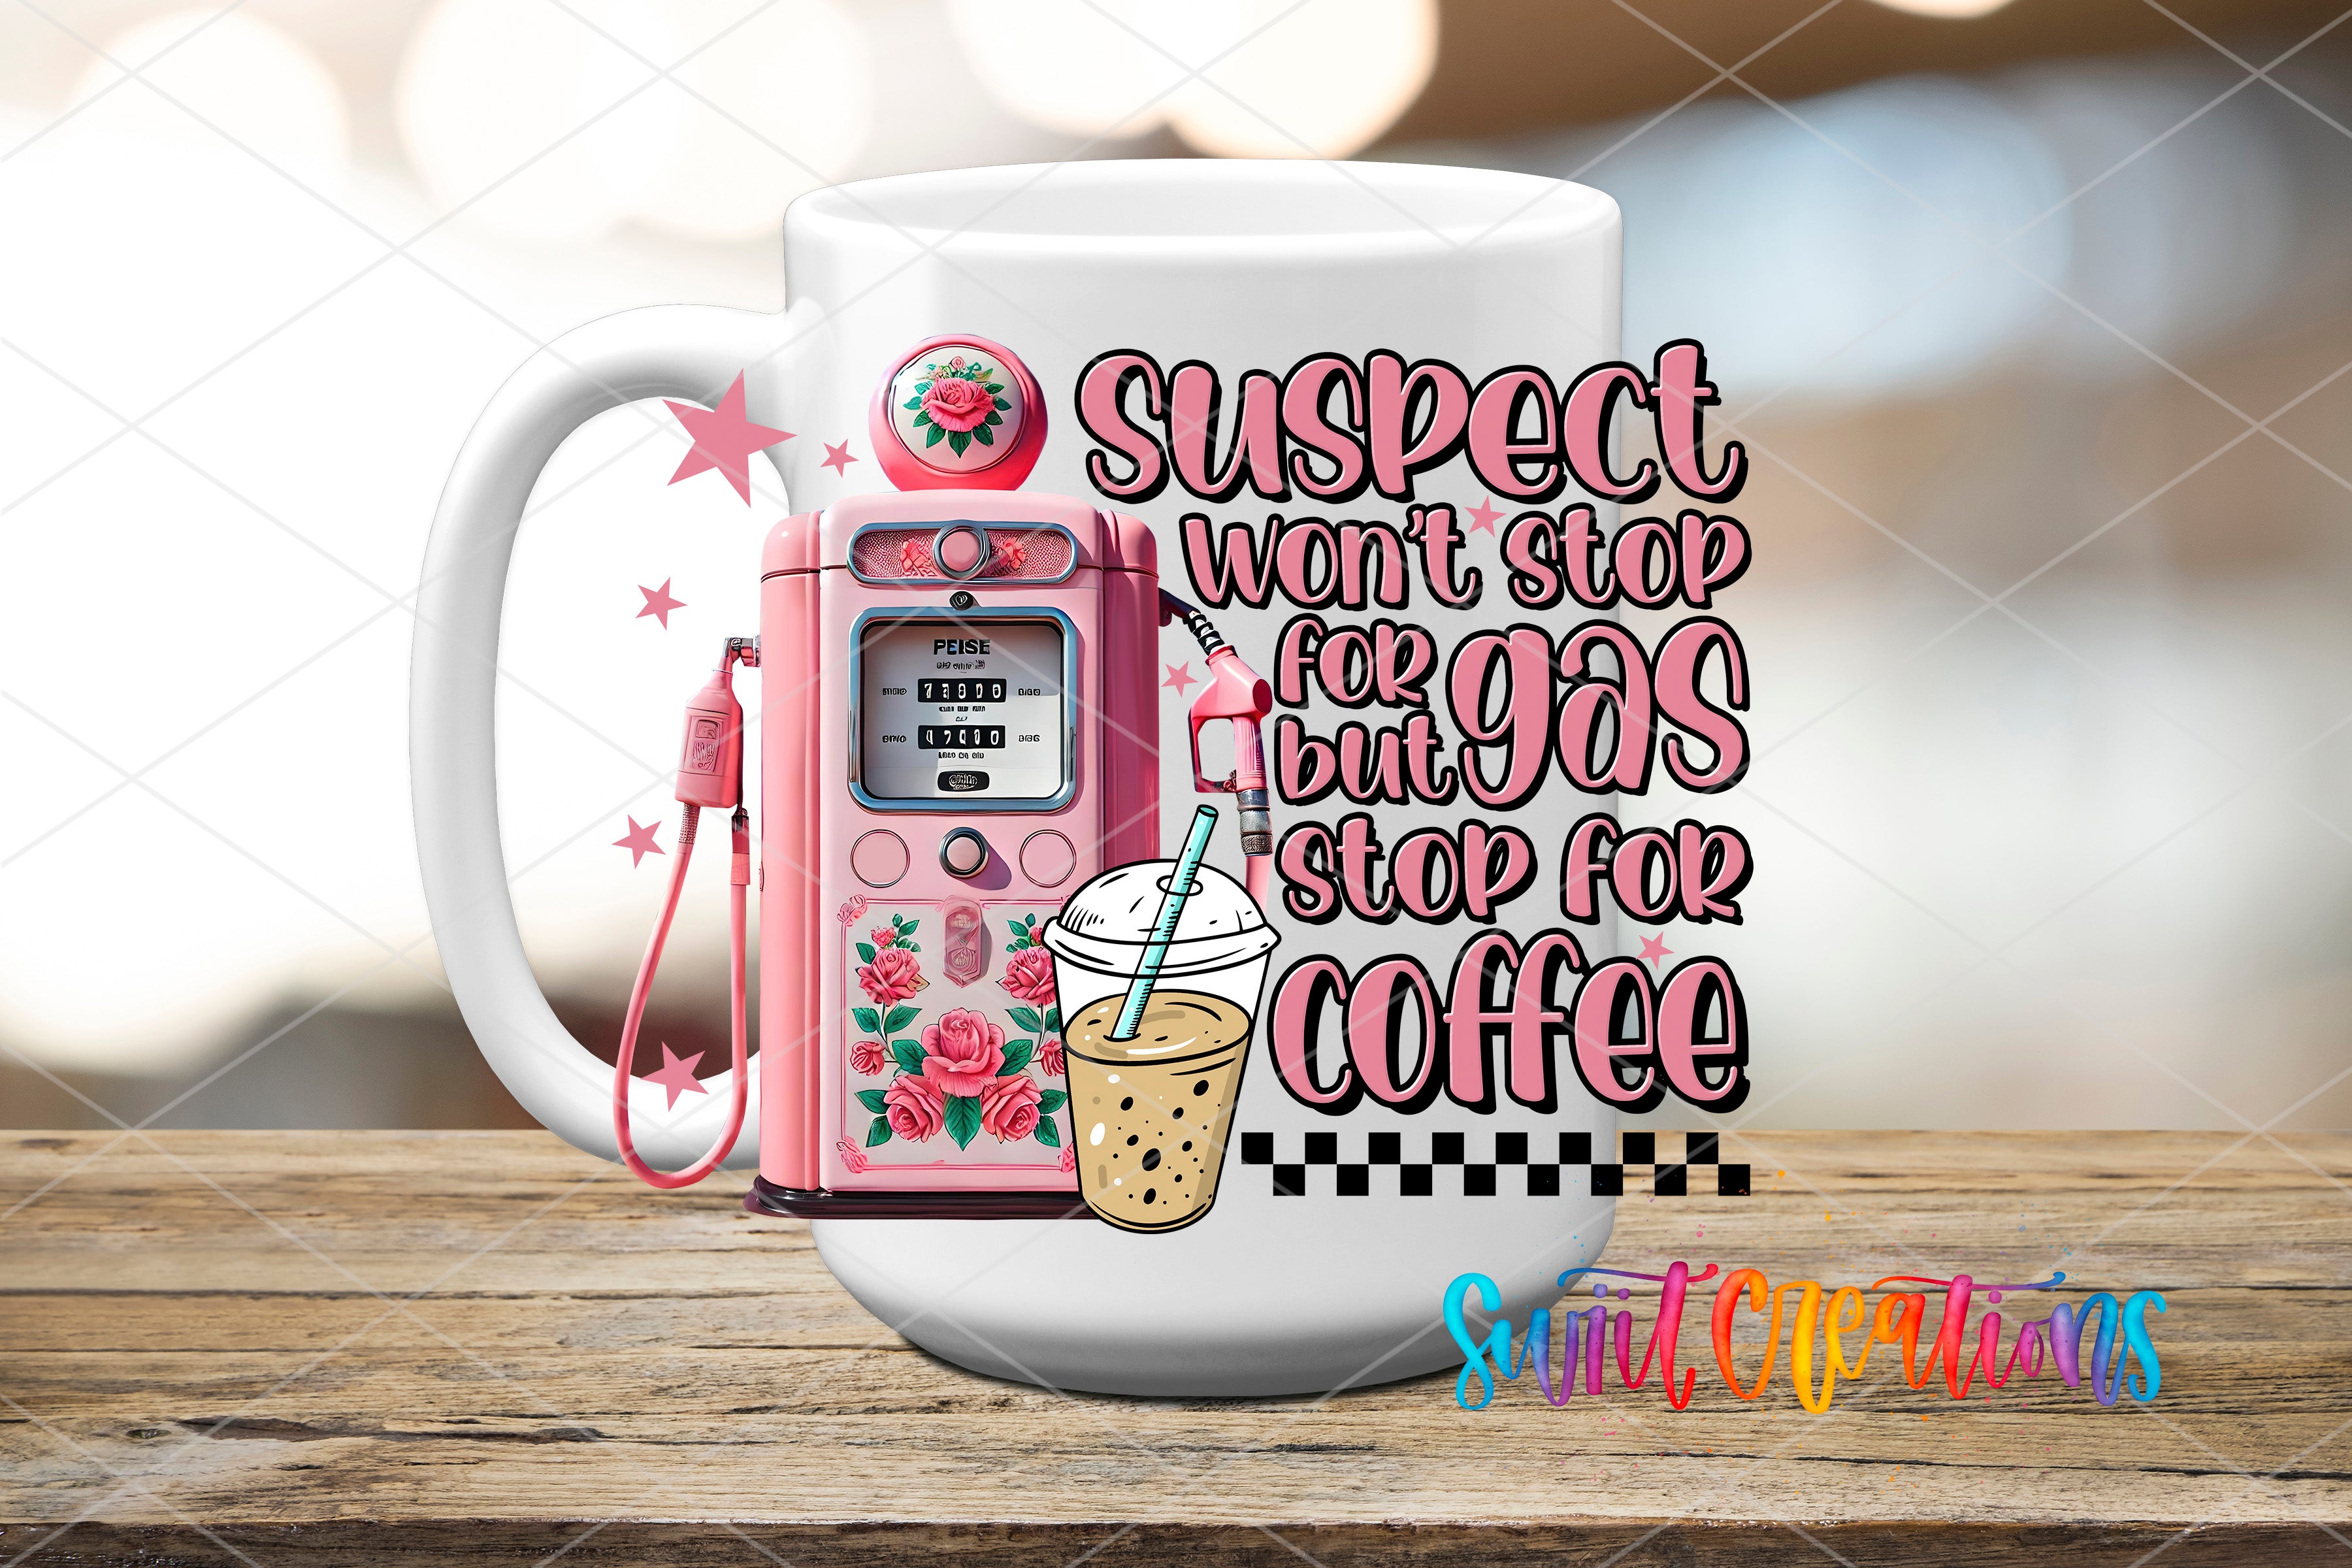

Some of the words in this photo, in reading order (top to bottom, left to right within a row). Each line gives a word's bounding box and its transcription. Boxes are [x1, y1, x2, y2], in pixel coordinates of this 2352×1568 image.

[1075, 338, 1748, 504] suspect
[1179, 502, 1484, 611] won't
[1500, 502, 1752, 611] stop
[1274, 710, 1461, 806] but
[1445, 616, 1751, 811] gas
[1275, 812, 1539, 925] stop
[1267, 928, 1751, 1116] coffee
